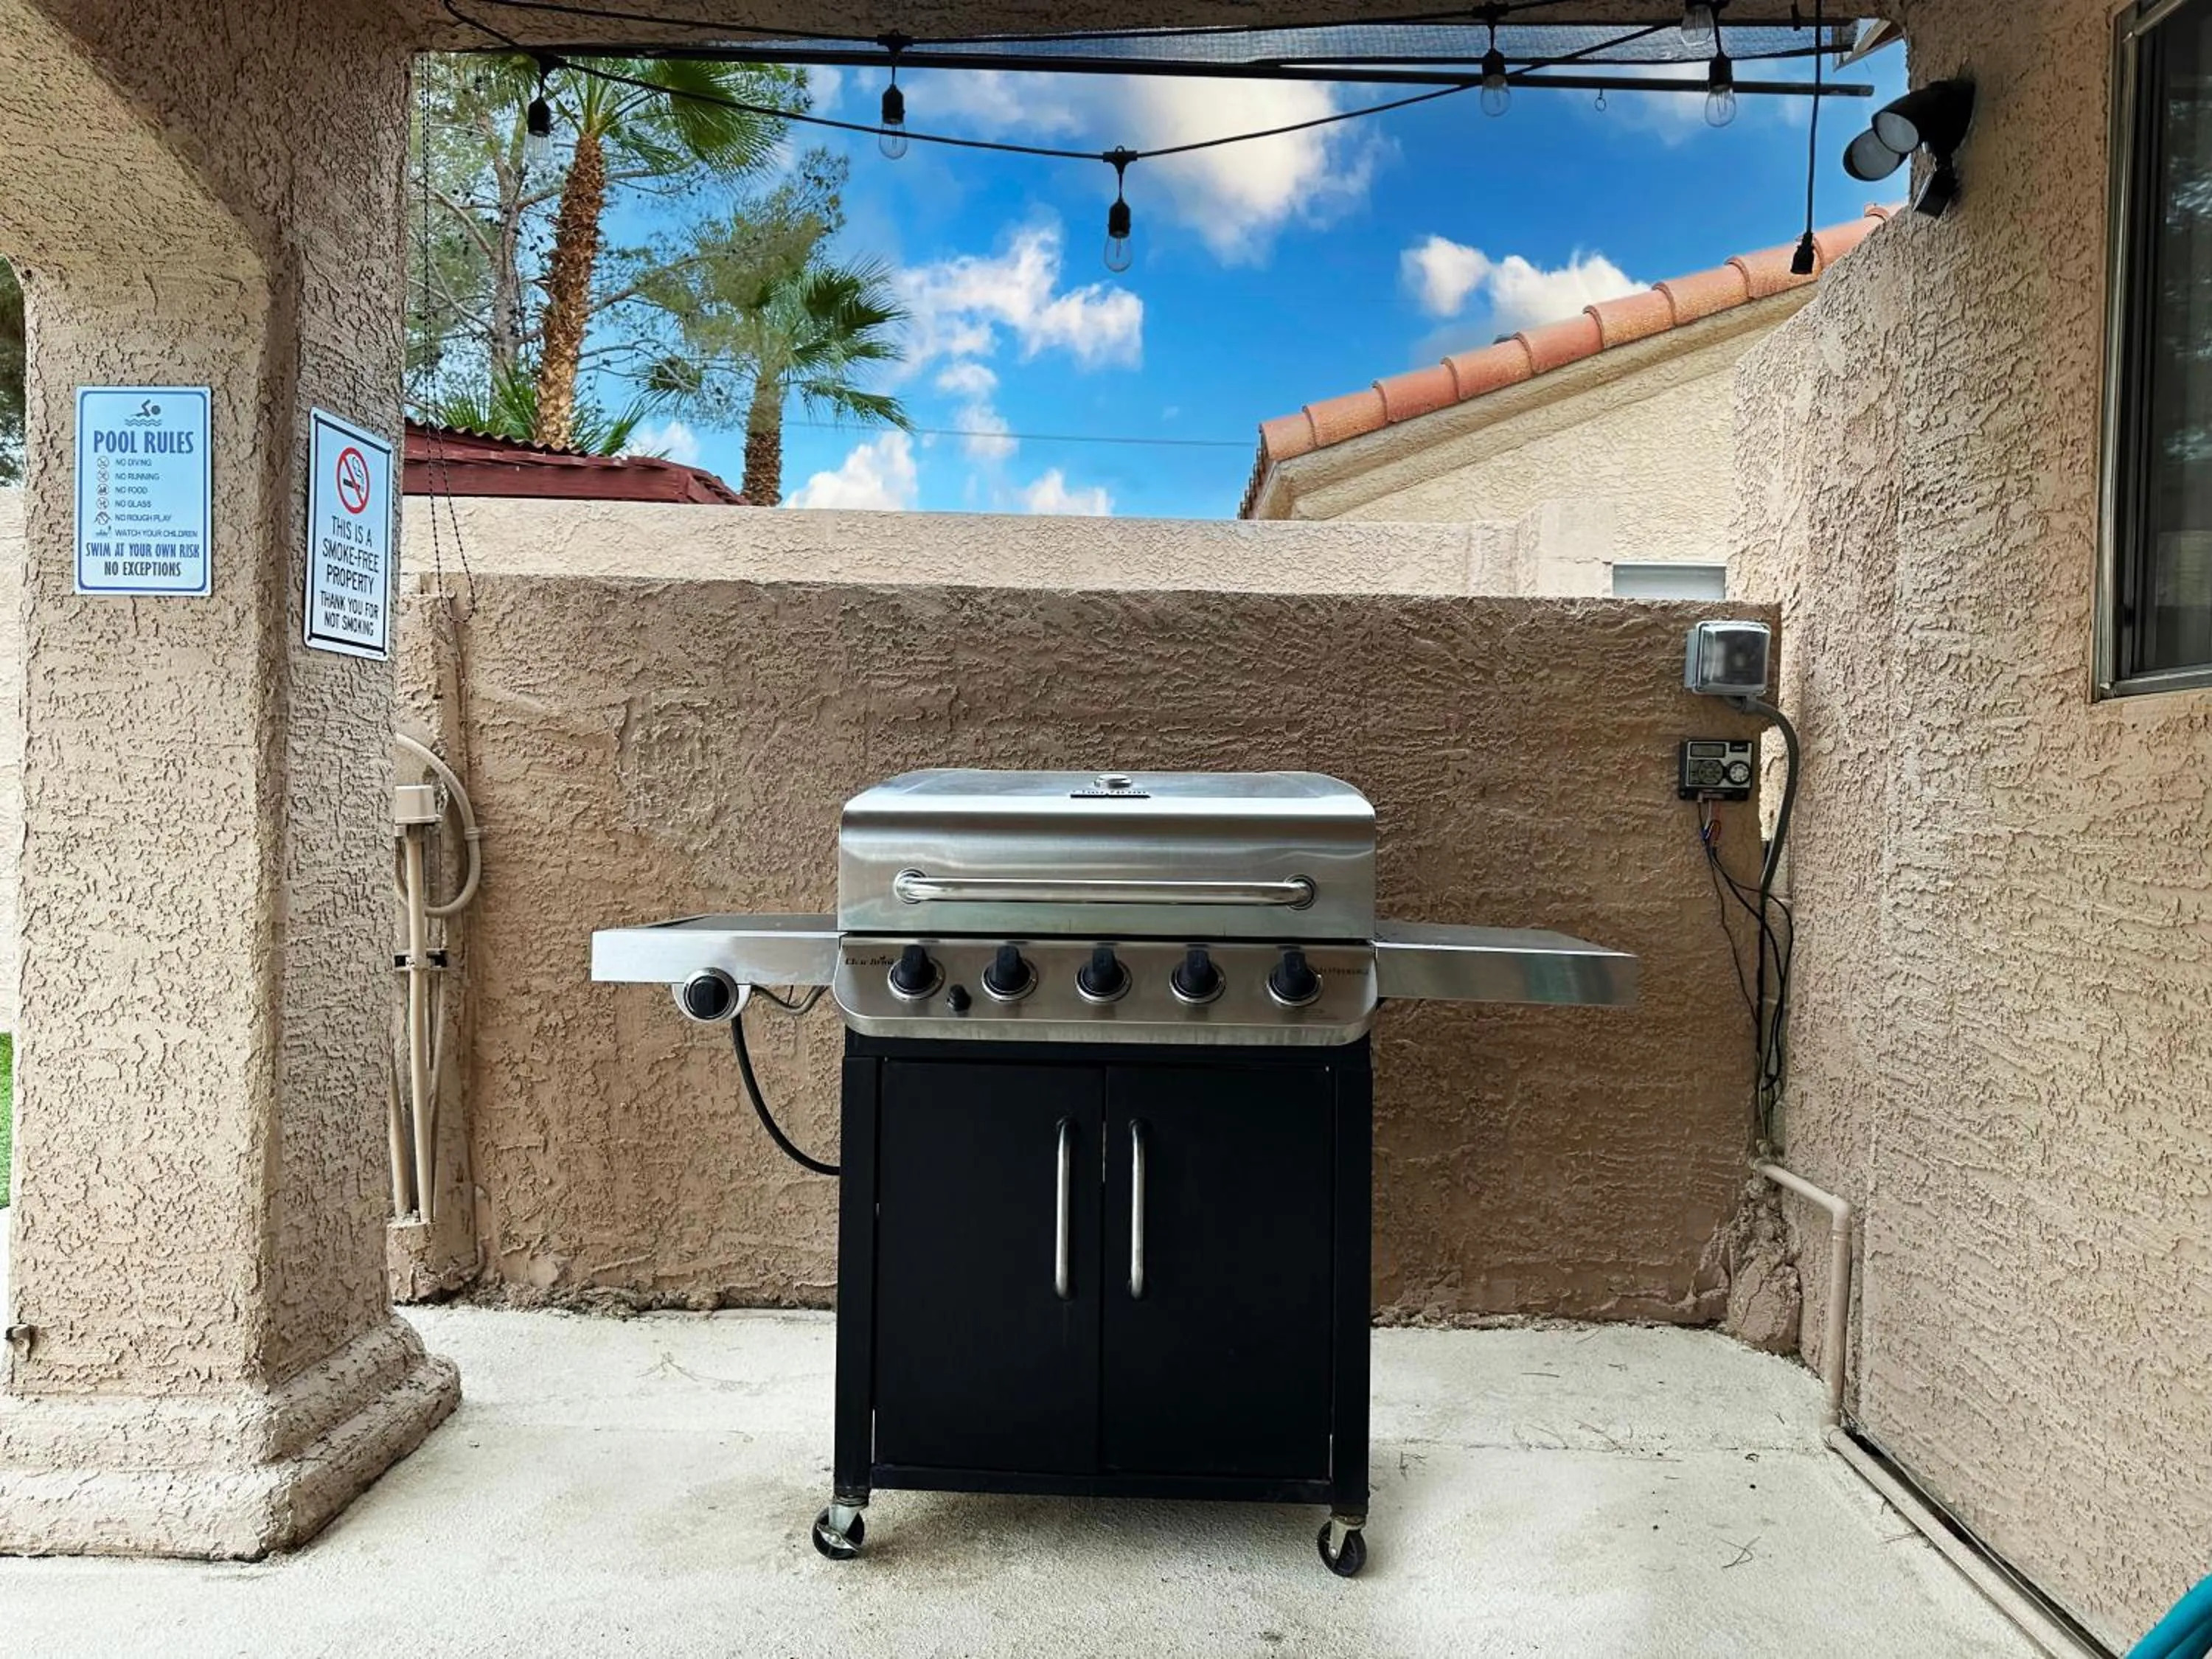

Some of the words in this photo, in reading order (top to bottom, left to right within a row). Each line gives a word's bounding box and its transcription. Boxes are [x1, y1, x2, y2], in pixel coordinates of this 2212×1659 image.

[94, 430, 137, 453] POOL
[144, 431, 194, 453] RULES
[116, 458, 126, 467] NO
[128, 458, 152, 467] DIVING
[115, 473, 126, 481] NO
[128, 473, 160, 481] RUNNING
[128, 500, 152, 508] GLASS
[153, 514, 171, 522] PLAY
[142, 529, 162, 538] YOUR
[163, 529, 198, 538] CHILDREN
[332, 515, 352, 540] THIS
[355, 524, 364, 544] IS
[366, 528, 372, 548] A
[86, 543, 111, 557] SWIM
[115, 543, 125, 557] AT
[129, 543, 153, 557] YOUR
[155, 543, 176, 557] OWN
[179, 543, 200, 558] RISK
[322, 538, 380, 574] SMOKE-FREE
[104, 562, 119, 576] NO
[122, 562, 181, 577] EXCEPTIONS
[327, 564, 375, 596] PROPERTY
[320, 590, 346, 611] THANK
[347, 597, 364, 616] YOU
[365, 602, 379, 620] FOR
[324, 611, 340, 629] NOT
[341, 614, 374, 636] SMOKING
